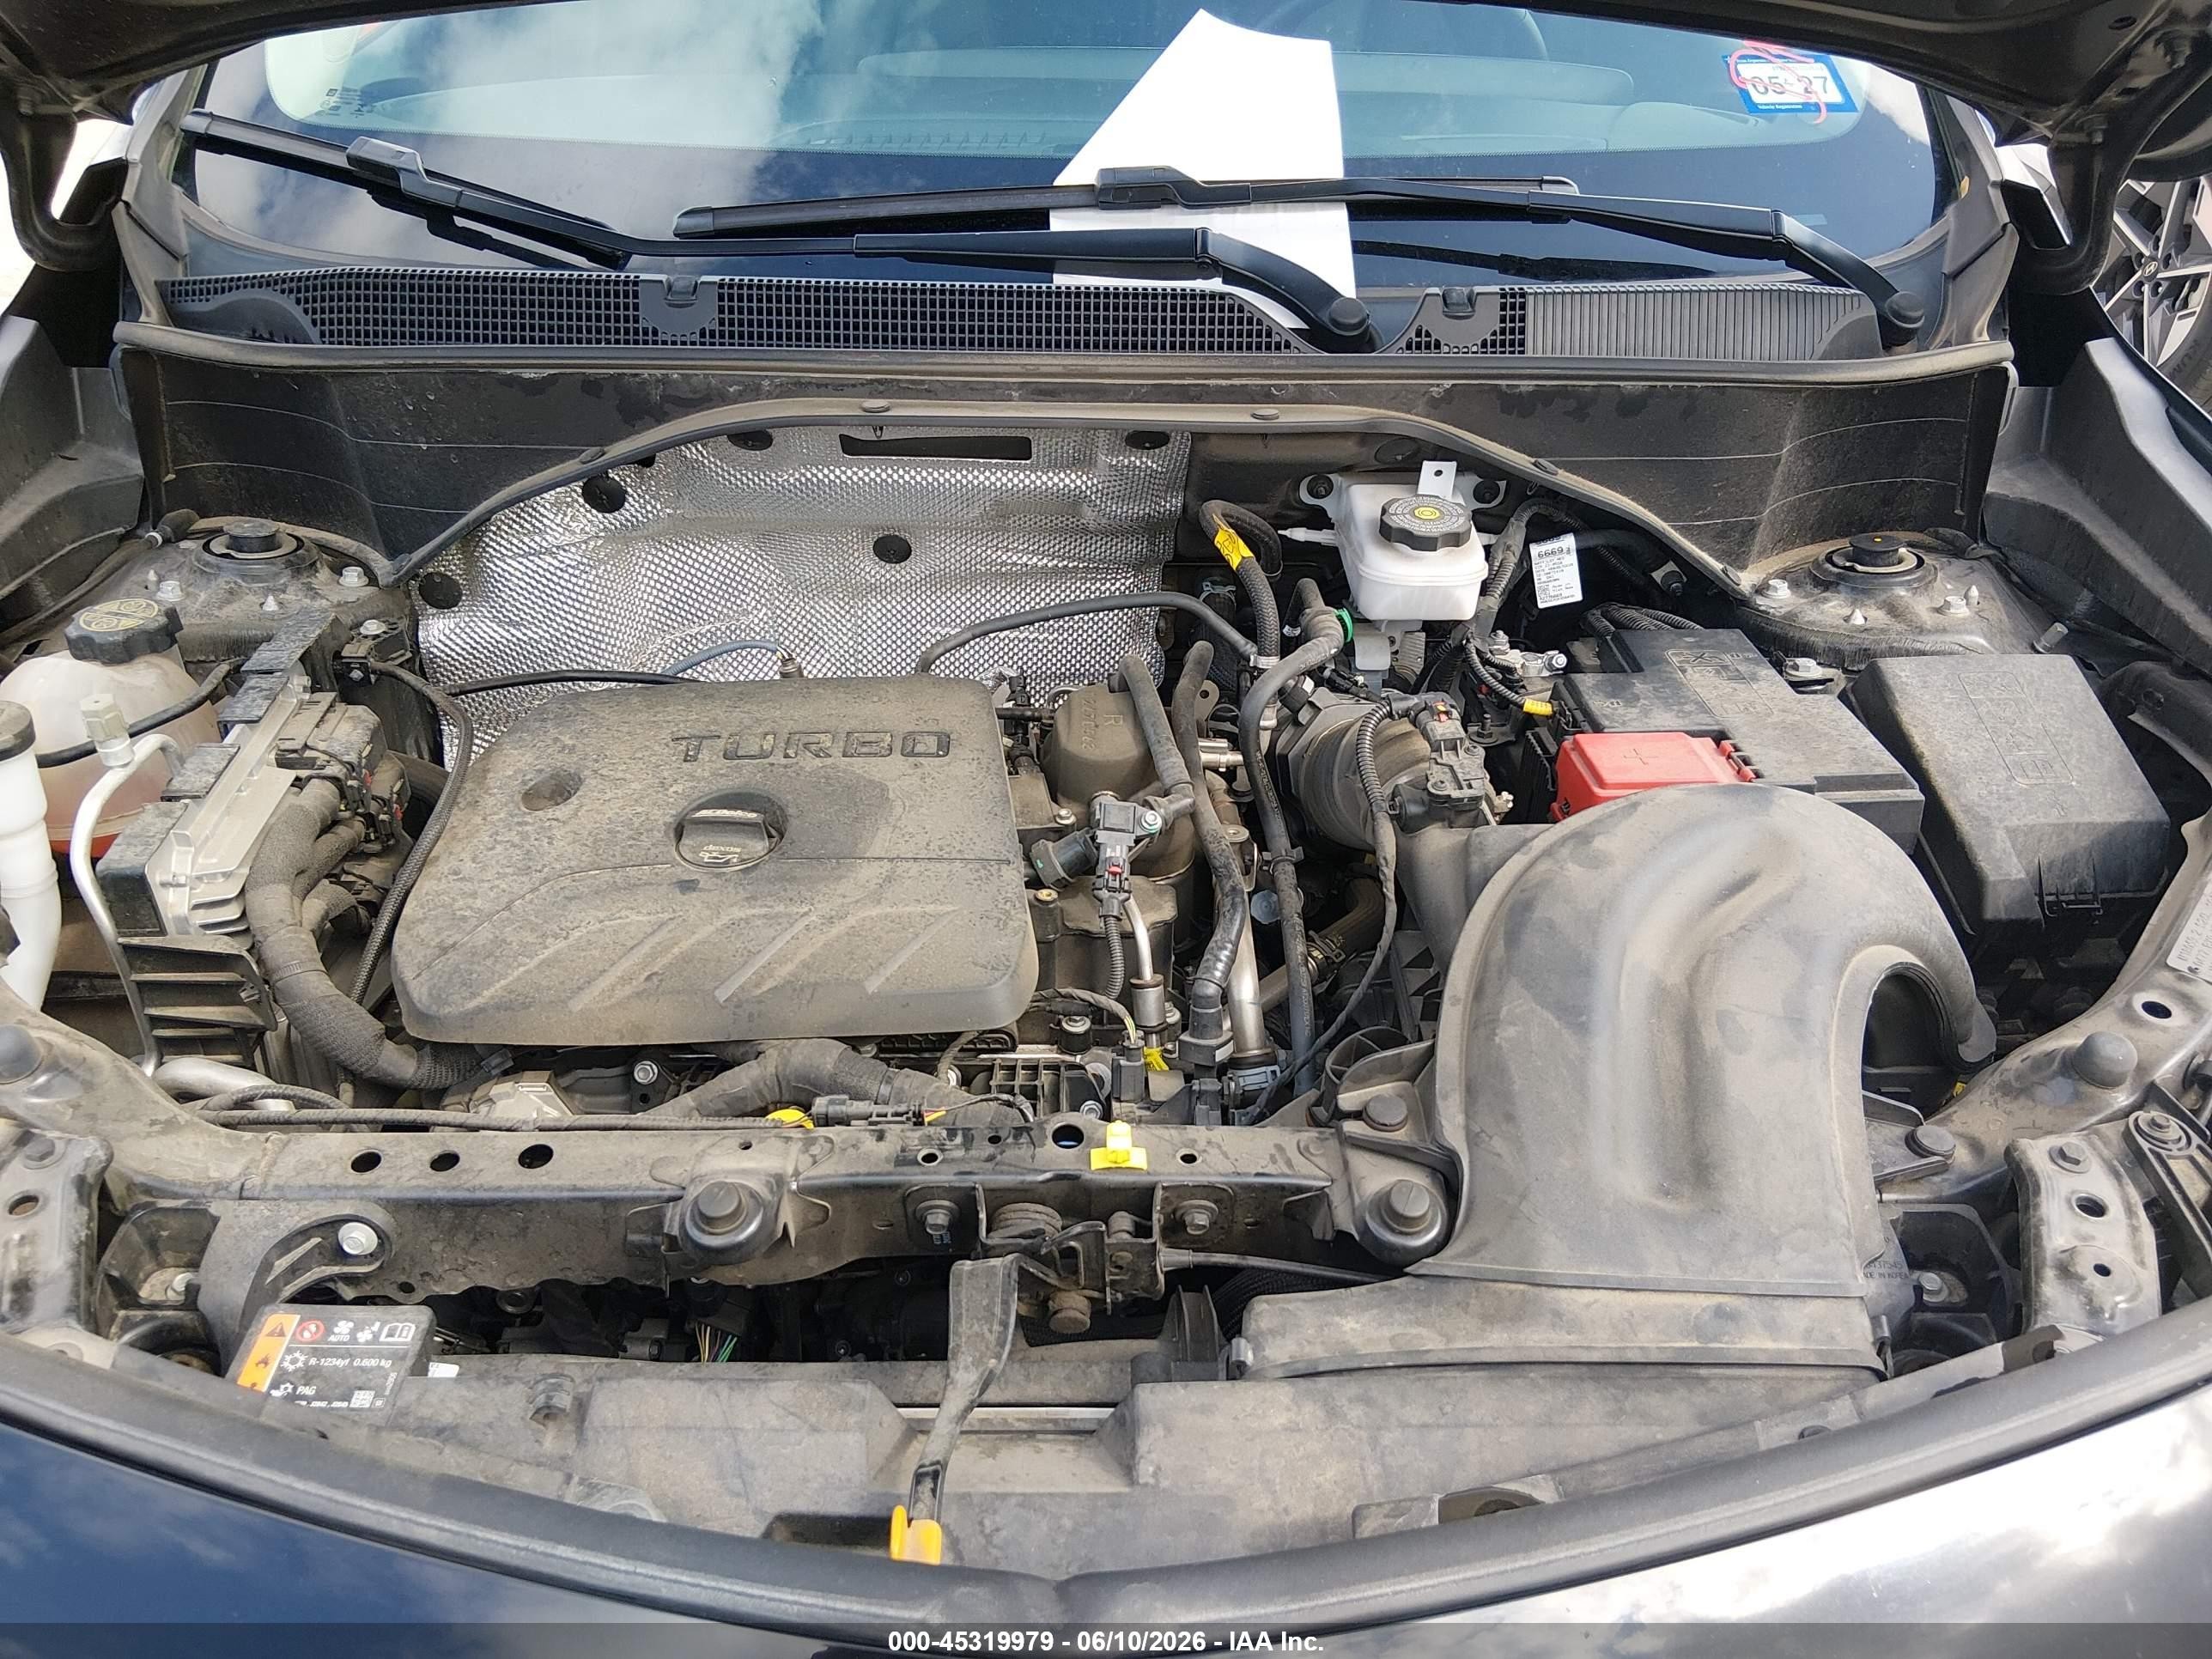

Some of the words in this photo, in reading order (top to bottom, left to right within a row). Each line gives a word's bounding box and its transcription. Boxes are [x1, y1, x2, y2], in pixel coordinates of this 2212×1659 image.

[1537, 545, 1565, 559] 6669
[1103, 714, 1123, 728] R
[672, 731, 951, 763] TURBO
[691, 808, 757, 818] ACDelco
[702, 844, 743, 853] dexos
[327, 1334, 350, 1342] AUTO
[380, 1358, 392, 1368] kg
[295, 1385, 317, 1395] PAG
